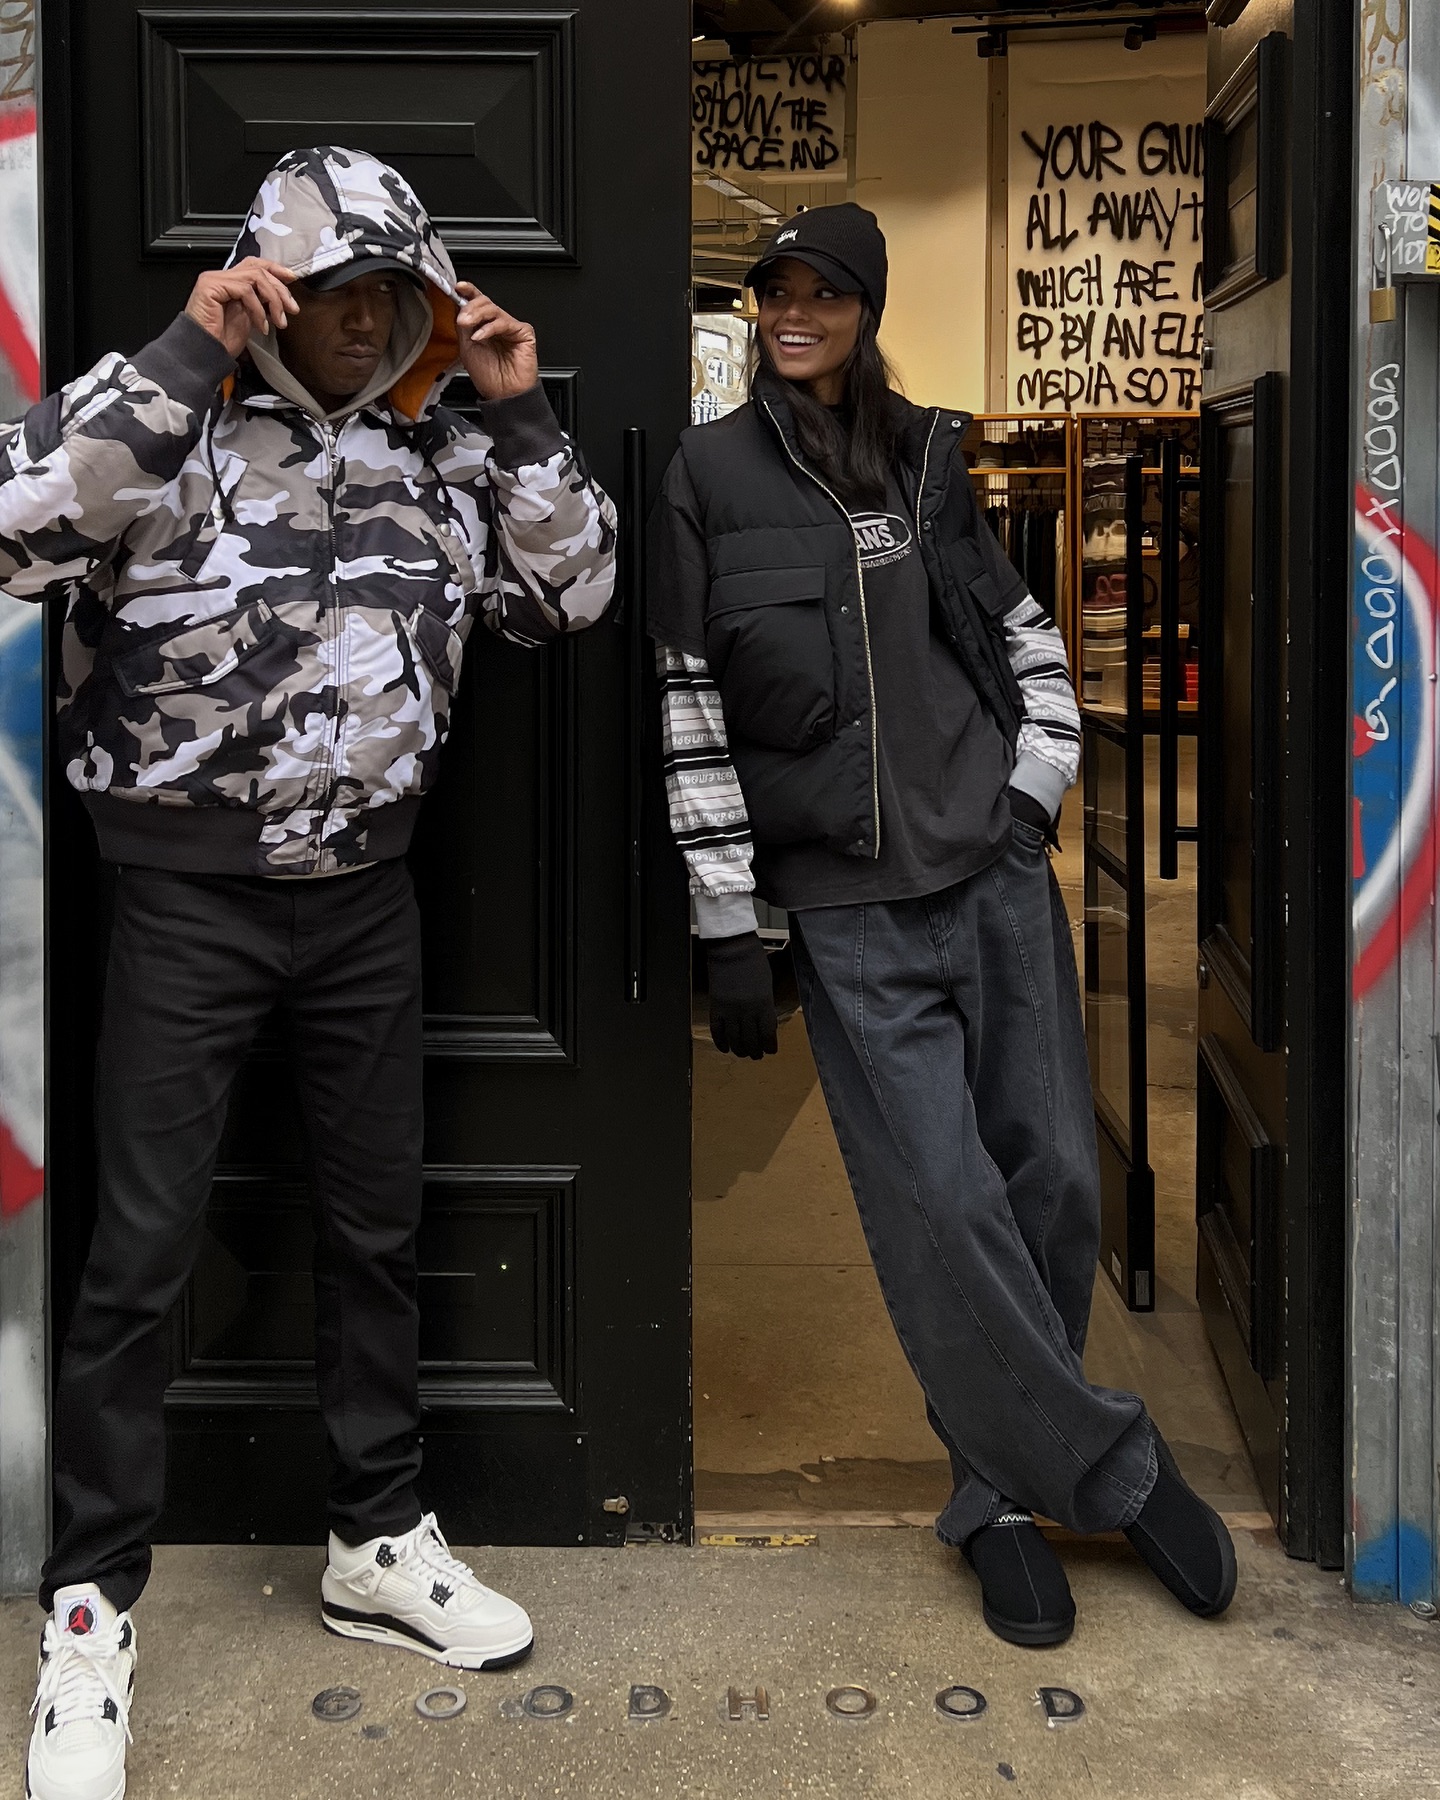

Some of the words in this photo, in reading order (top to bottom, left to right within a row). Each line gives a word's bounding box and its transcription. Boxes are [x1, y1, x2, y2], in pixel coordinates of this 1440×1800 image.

[787, 55, 846, 92] YOUR
[781, 97, 833, 135] THE
[697, 126, 785, 170] SPACE
[791, 135, 839, 171] AND
[1021, 120, 1126, 189] YOUR
[1027, 188, 1078, 250] ALL
[1087, 187, 1180, 250] AWAY
[1017, 254, 1103, 309] WHICH
[1114, 260, 1178, 308] ARE
[1018, 312, 1053, 359] ED
[1060, 310, 1096, 363] BY
[1103, 313, 1146, 359] AN
[1017, 362, 1118, 411] MEDIA
[854, 525, 895, 550] ANS
